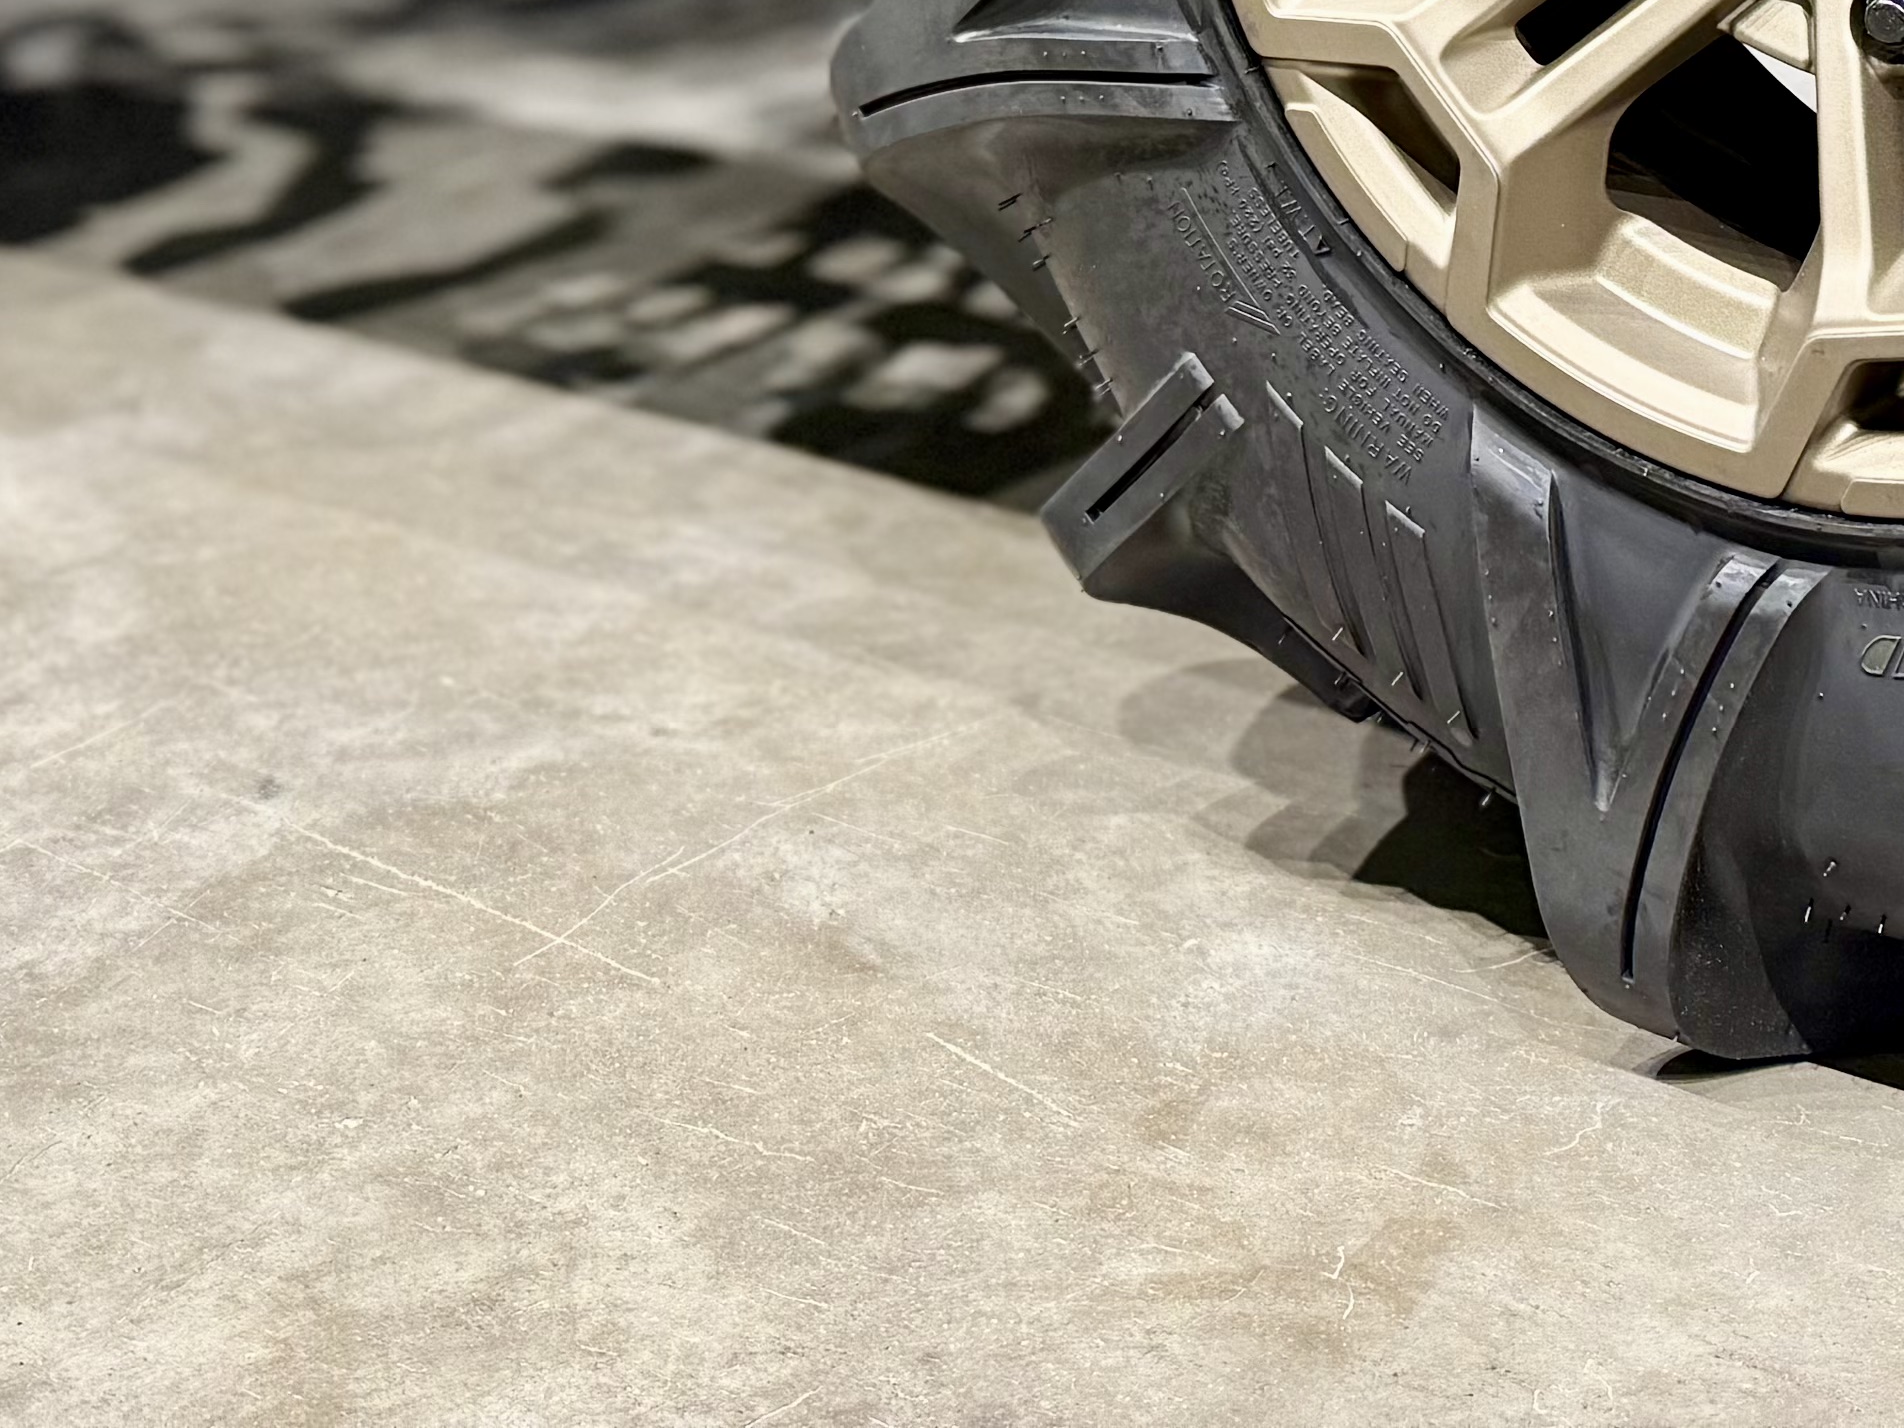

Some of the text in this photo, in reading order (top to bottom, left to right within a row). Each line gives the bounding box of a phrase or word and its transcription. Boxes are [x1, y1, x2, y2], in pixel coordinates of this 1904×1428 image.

[1165, 199, 1237, 303] ROTATION
[1247, 184, 1300, 260] TUBELESS
[1349, 367, 1377, 397] FOR
[1314, 385, 1413, 486] WARNING:
[1395, 432, 1425, 463] SEE
